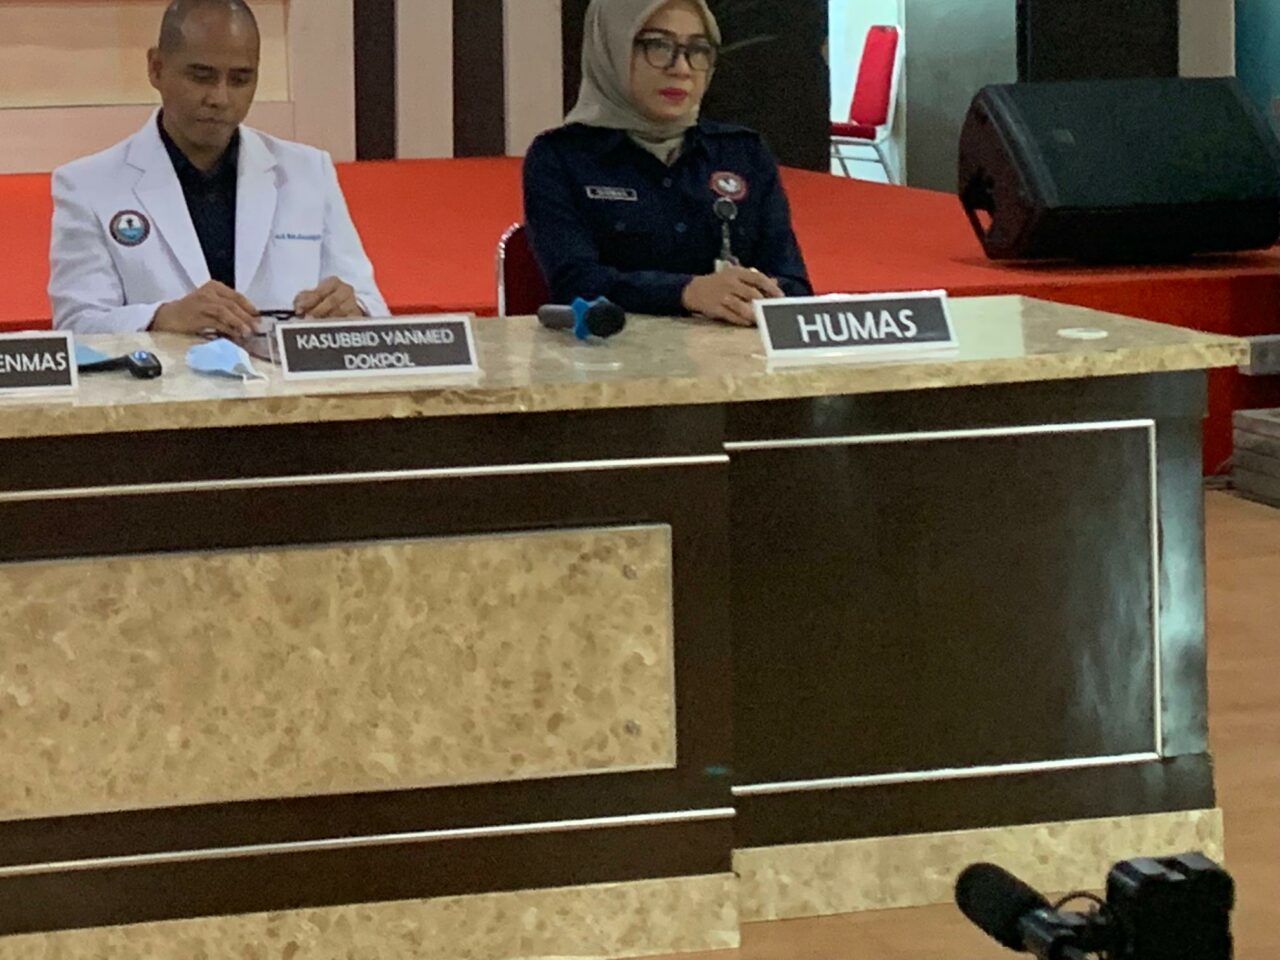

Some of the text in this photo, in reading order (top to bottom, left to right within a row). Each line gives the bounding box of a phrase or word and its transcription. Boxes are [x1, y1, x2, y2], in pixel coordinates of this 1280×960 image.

[796, 308, 919, 344] HUMAS
[295, 328, 455, 350] KASUBBID YANMED
[343, 352, 416, 370] DOKPOL
